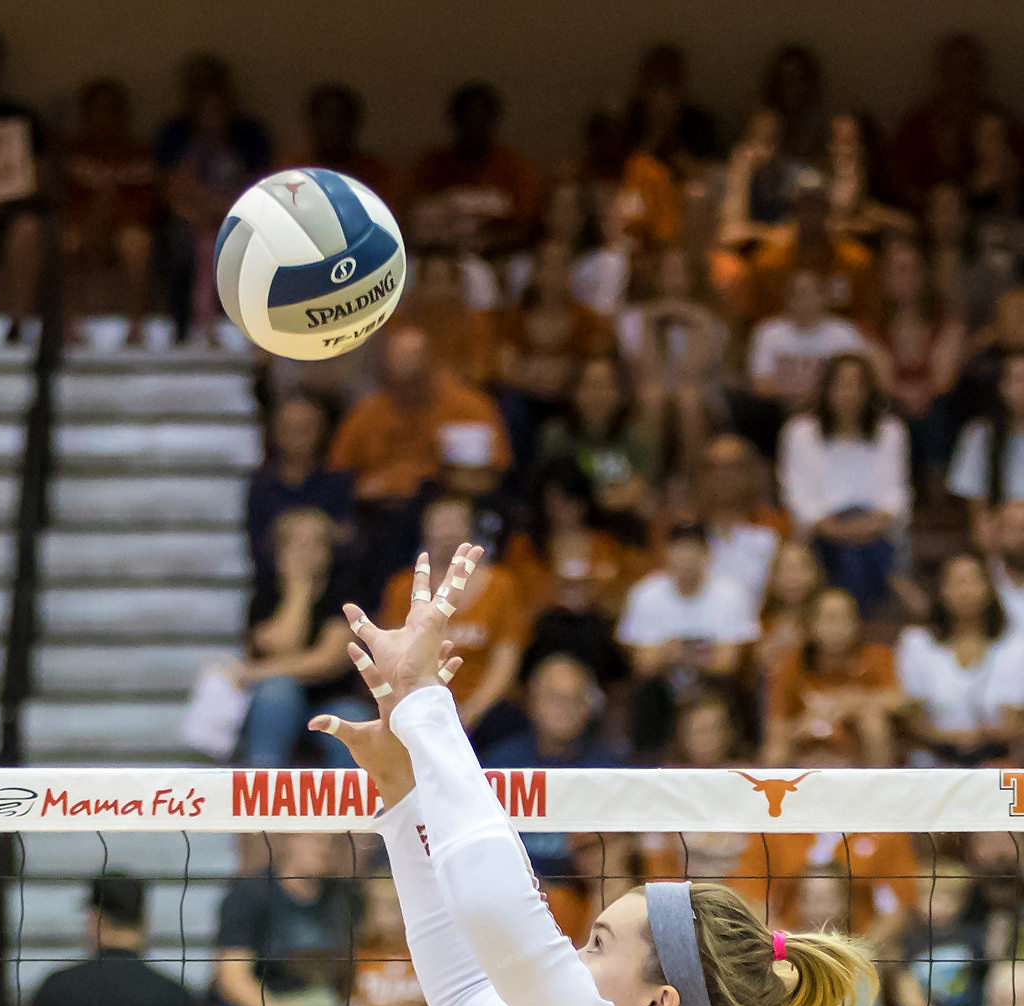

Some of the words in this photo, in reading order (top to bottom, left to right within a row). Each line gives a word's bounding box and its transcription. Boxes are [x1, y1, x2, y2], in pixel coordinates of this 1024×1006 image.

[305, 270, 397, 329] SPALDING
[41, 788, 144, 817] Mama
[151, 788, 206, 818] Fu's
